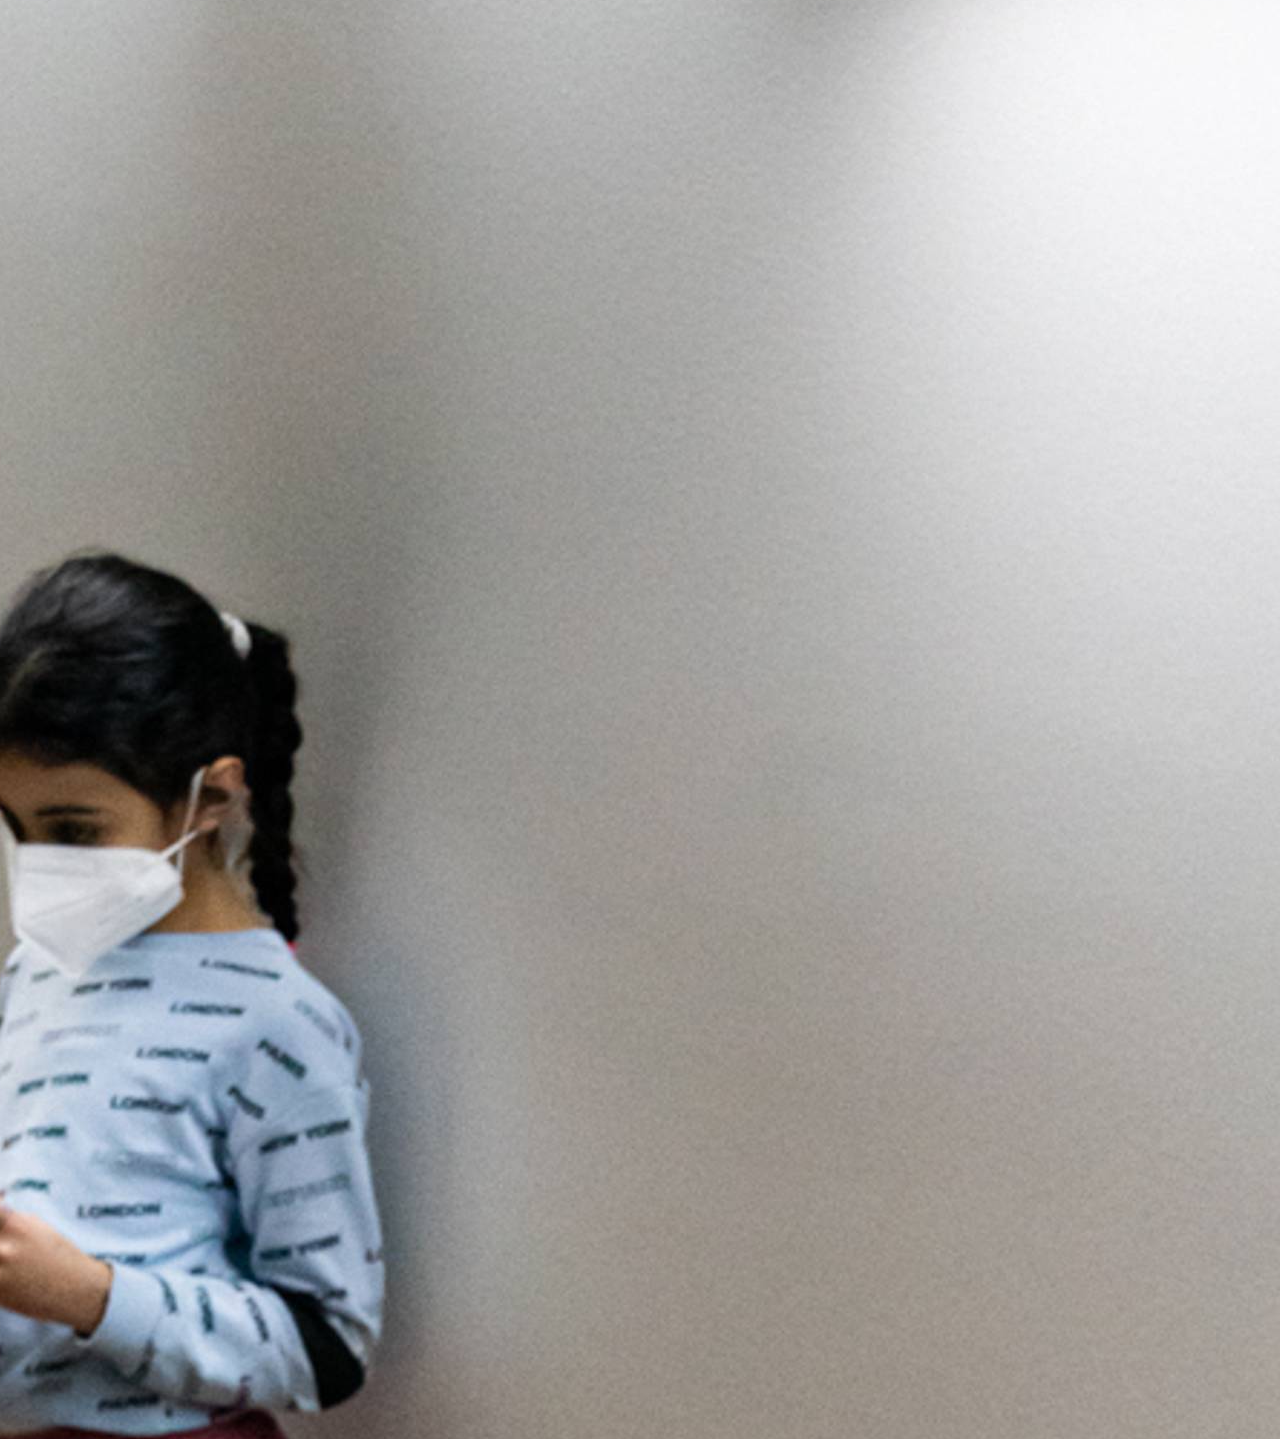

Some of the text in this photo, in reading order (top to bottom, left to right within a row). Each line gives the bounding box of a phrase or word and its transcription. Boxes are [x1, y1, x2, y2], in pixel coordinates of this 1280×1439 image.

[169, 1000, 245, 1017] LONDON
[136, 1046, 211, 1063] LONDON
[77, 1202, 164, 1219] LONDON
